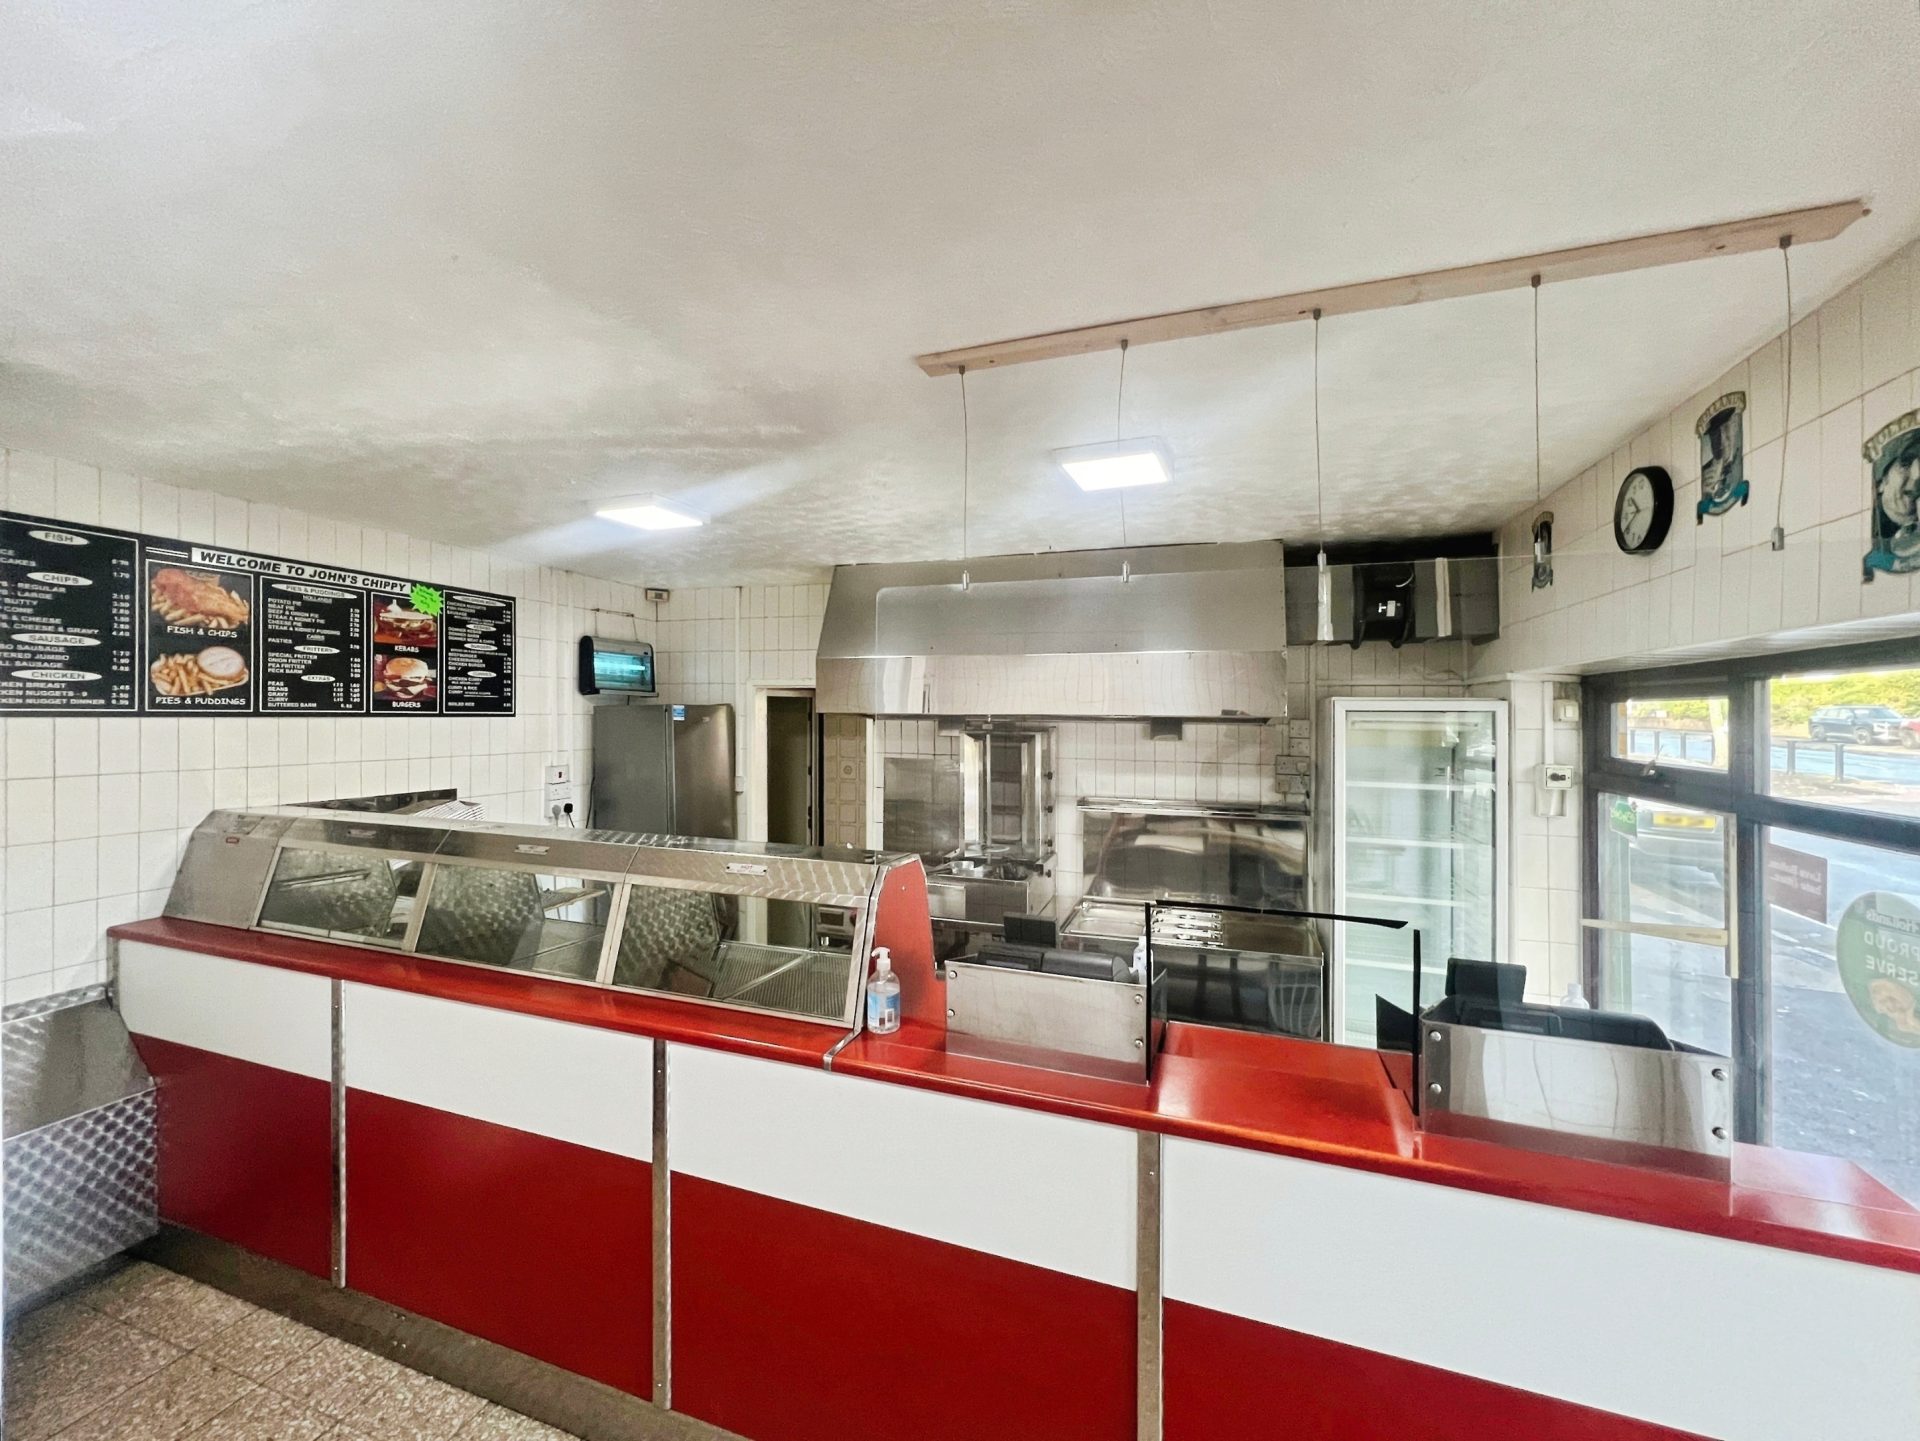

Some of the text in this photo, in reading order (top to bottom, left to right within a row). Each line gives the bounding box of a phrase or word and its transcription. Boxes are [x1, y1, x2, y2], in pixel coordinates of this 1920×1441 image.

[45, 532, 73, 543] FISH
[200, 551, 406, 592] WELCOME TO JOHN'S CHIPPY
[43, 574, 80, 584] CHIPS
[17, 582, 67, 593] REGULAR
[17, 591, 54, 600] LARGE
[311, 588, 345, 598] PUDDINGS
[4, 598, 39, 606] BUTTY
[21, 615, 63, 624] CHEESE
[13, 623, 56, 632] CHEESE
[167, 626, 194, 635] FISH
[208, 629, 238, 638] CHIPS
[29, 634, 86, 645] SAUSAGE
[16, 644, 66, 653] SAUSAGE
[394, 645, 420, 653] KEBABS
[34, 653, 70, 661] JUMBO
[14, 660, 64, 669] SAUSAGE
[31, 671, 85, 680] CHICKEN
[26, 682, 67, 690] BREAST
[155, 697, 246, 706] PIES & PUDDINGS
[392, 701, 422, 709] BURGERS
